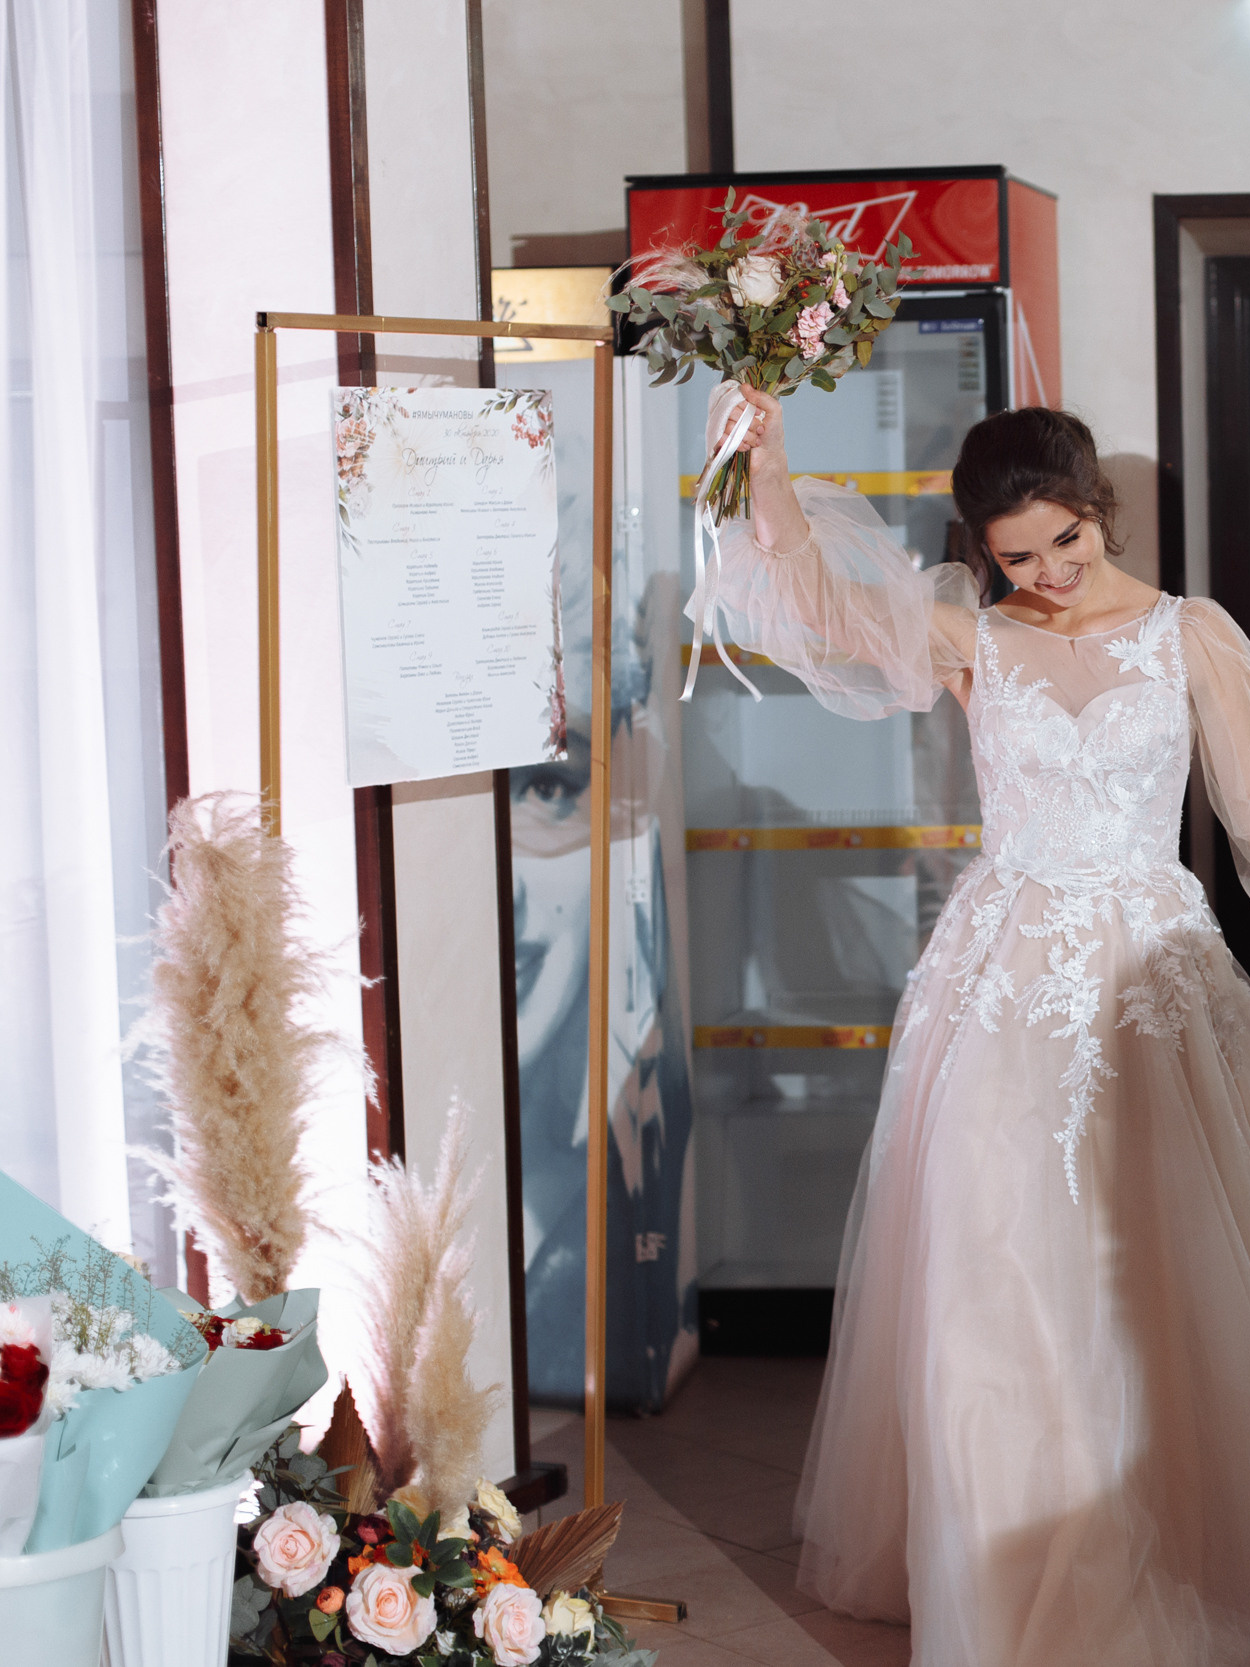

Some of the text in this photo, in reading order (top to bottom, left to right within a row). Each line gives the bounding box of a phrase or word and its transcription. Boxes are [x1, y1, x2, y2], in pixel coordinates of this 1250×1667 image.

[748, 201, 864, 255] Bd
[412, 410, 474, 420] #ЯМЫЧУМАНОВЫ
[402, 448, 457, 487] Дмитрий
[470, 447, 504, 485] Дарья
